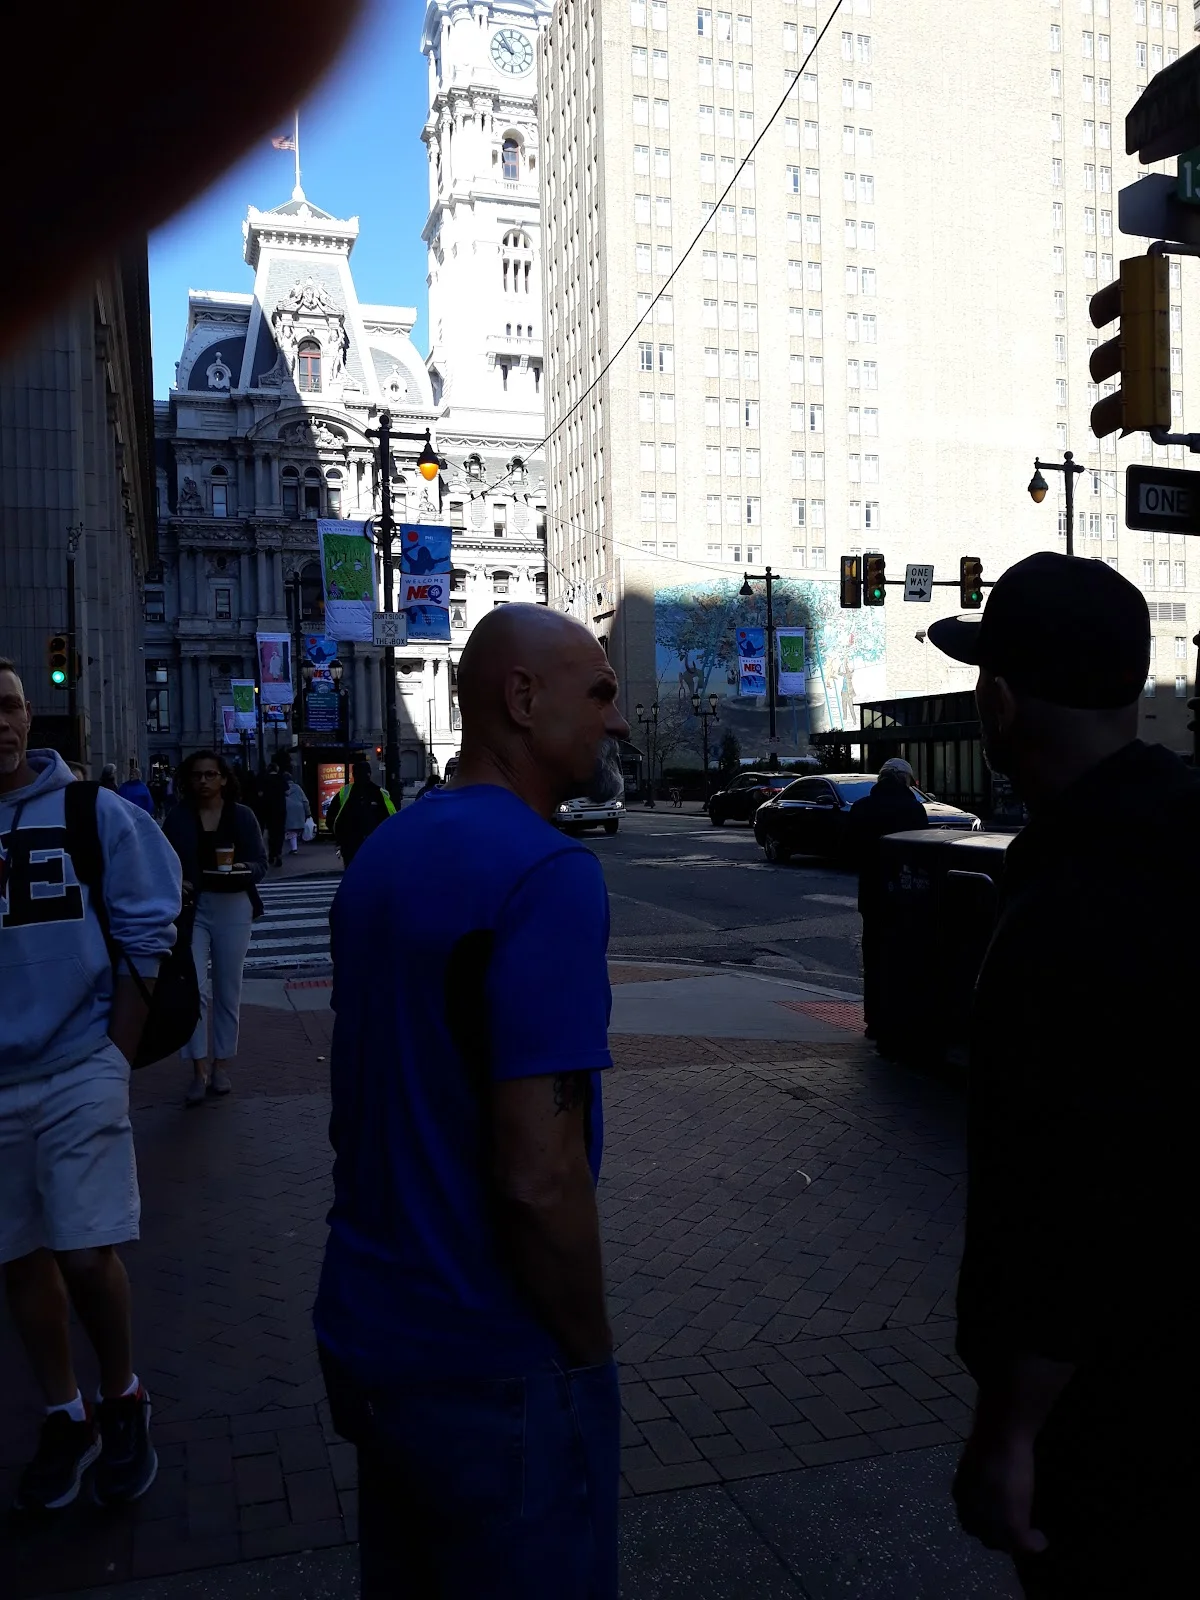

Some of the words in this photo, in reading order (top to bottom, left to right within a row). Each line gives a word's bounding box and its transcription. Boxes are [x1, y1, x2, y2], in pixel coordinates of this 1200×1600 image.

[1145, 487, 1189, 513] ONE
[911, 568, 929, 577] ONE
[910, 577, 929, 586] WAY
[406, 584, 443, 605] NEQ
[375, 637, 389, 645] THE
[391, 637, 405, 645] BOX
[744, 664, 763, 675] NEQ
